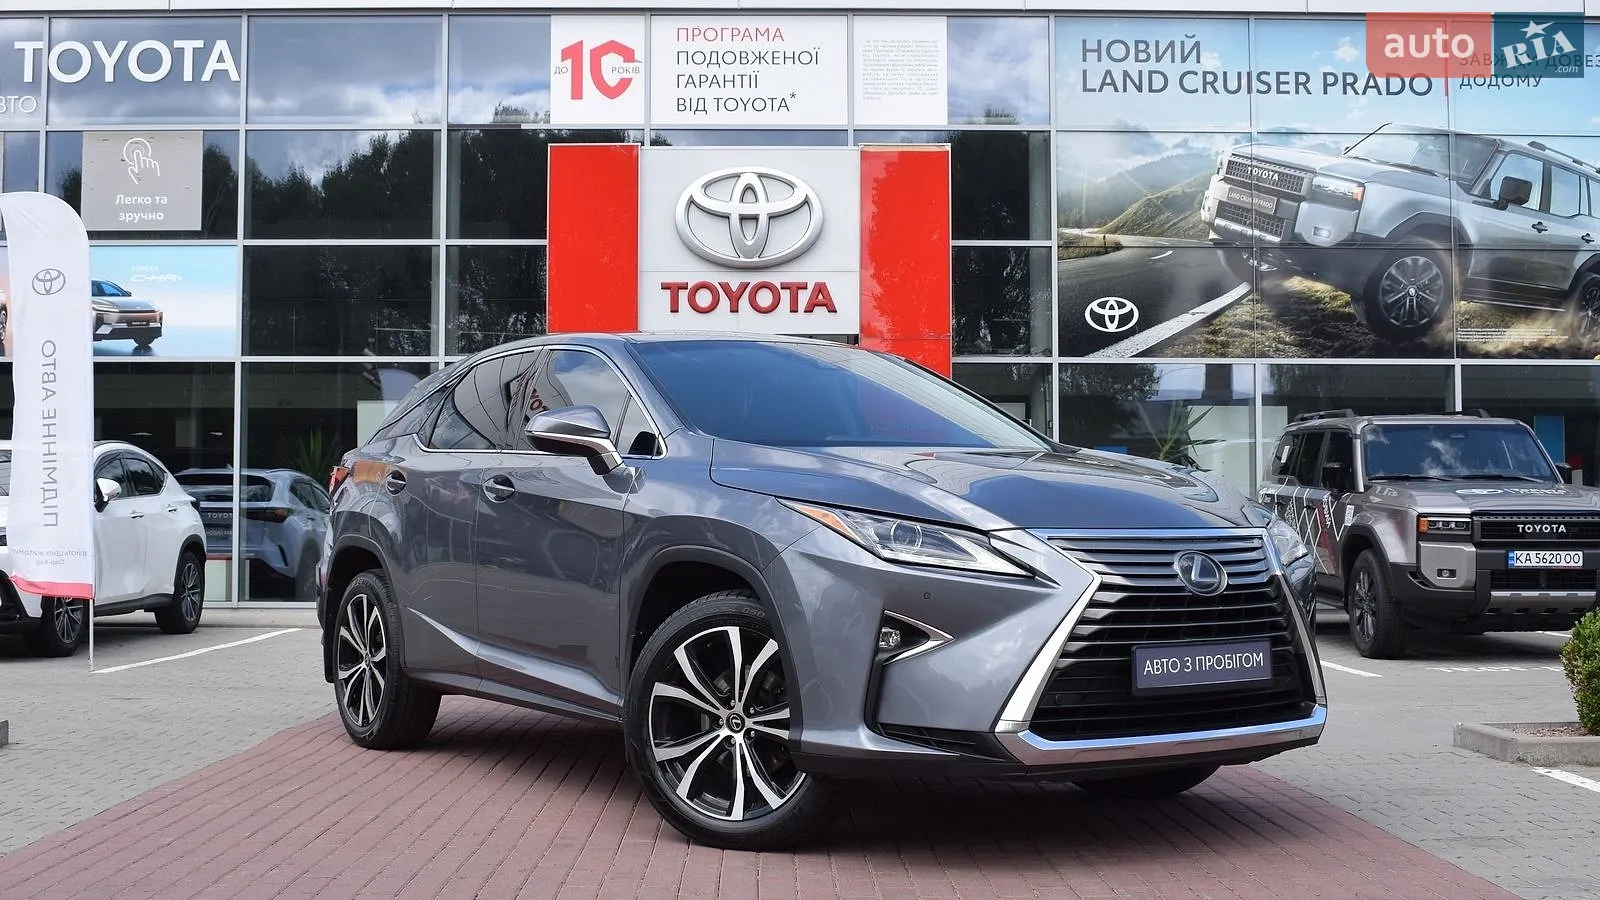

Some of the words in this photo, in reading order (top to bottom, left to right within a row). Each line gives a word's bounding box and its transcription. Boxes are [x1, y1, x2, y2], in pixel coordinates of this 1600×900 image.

[676, 27, 785, 42] ПРОГРАМА
[676, 47, 820, 68] ПОДОВЖЕНОЇ
[1080, 34, 1202, 64] НОВИЙ
[14, 40, 240, 83] TOYOTA
[611, 66, 641, 74] РОКІВ
[676, 70, 760, 89] ГАРАНТІЇ
[1081, 69, 1169, 94] LAND
[1178, 70, 1312, 96] CRUISER
[1322, 71, 1433, 96] PRADO
[1459, 73, 1542, 90] ДОДОМУ
[676, 97, 708, 115] ВІД
[1247, 166, 1279, 181] TOYOTA
[114, 194, 152, 205] Легко
[154, 196, 168, 205] та
[118, 211, 165, 223] зручно
[660, 280, 838, 314] TOYOTA
[1516, 524, 1567, 533] TOYOTA
[1515, 553, 1532, 564] KA
[1535, 553, 1562, 564] 5620
[1143, 657, 1181, 676] АВТО
[1195, 651, 1264, 672] ПРОБІГОМ
